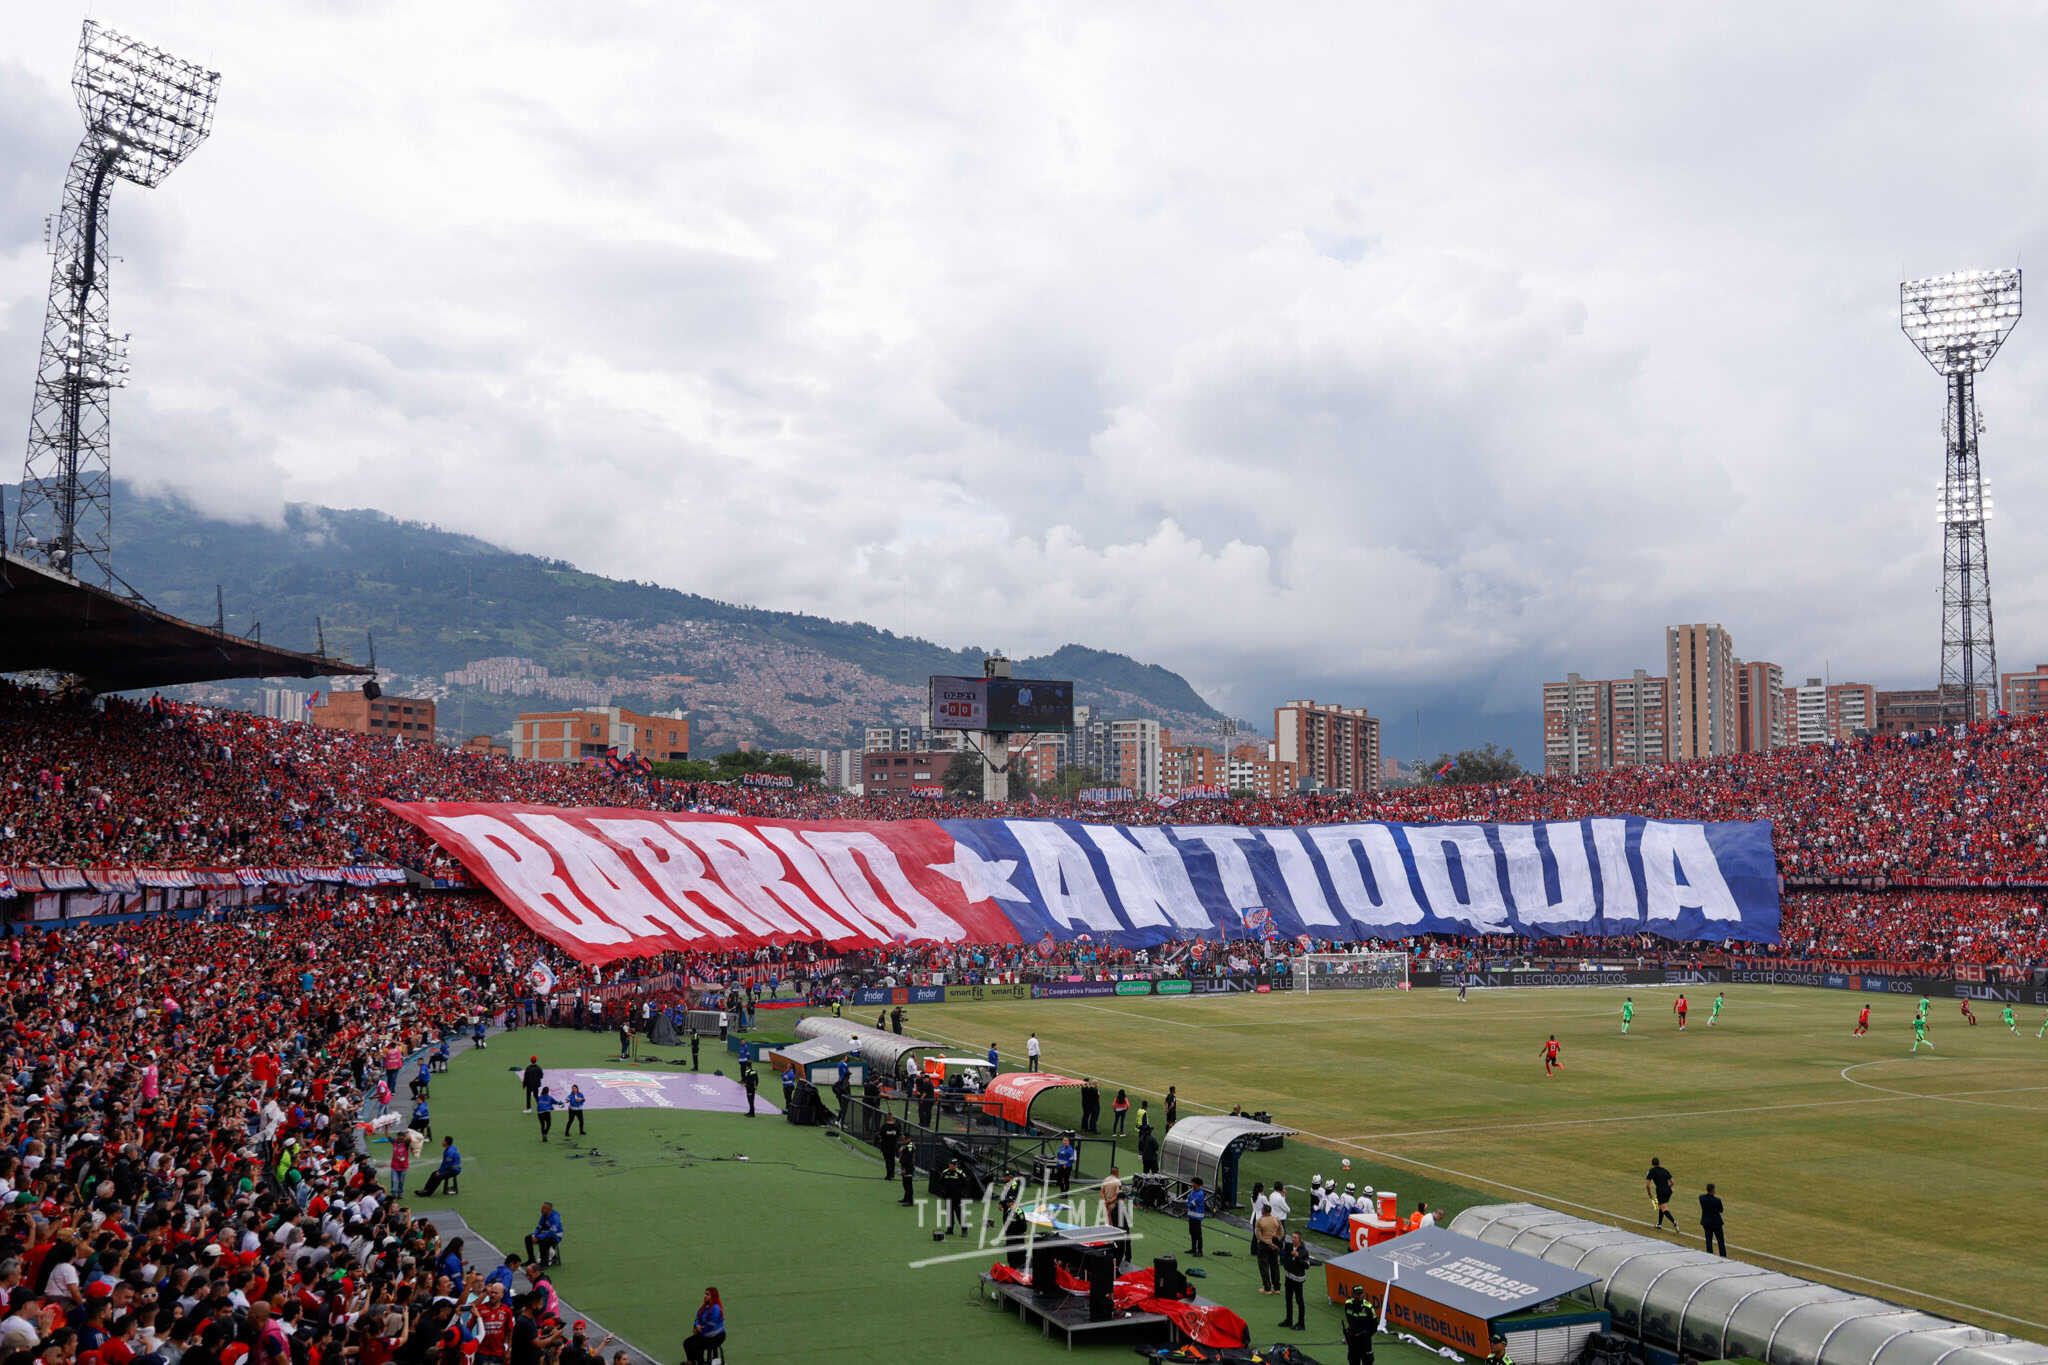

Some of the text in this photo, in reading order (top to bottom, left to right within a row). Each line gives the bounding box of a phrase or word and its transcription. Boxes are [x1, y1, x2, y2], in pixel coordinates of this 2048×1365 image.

[427, 813, 1743, 945] BARRIO ANTIOQUIA
[1193, 979, 1257, 993] SWAN
[1665, 970, 1720, 983] SWAN
[1954, 983, 2021, 1001] SWAN
[1356, 1227, 1369, 1248] G
[1425, 1267, 1523, 1301] GIRARDOT
[1442, 1260, 1540, 1295] ATANASIO
[1395, 1304, 1411, 1322] DE
[1413, 1309, 1477, 1348] MEDELLÍN
